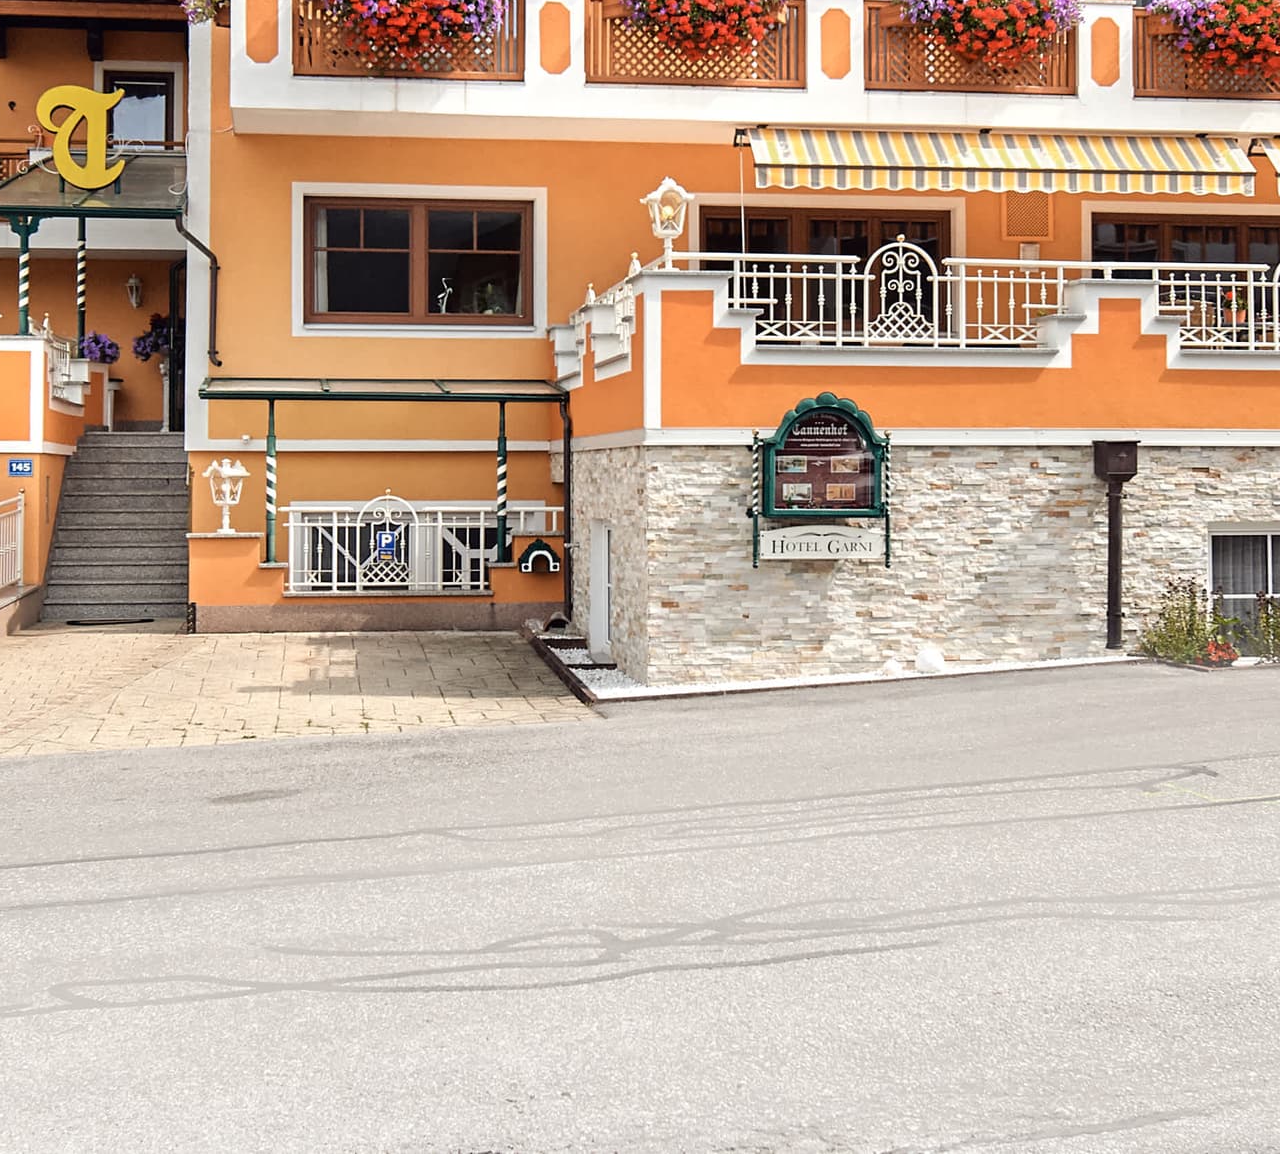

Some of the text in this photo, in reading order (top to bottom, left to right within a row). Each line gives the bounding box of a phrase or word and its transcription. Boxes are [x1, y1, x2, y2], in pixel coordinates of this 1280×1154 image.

[792, 423, 848, 436] Tannenhof
[11, 462, 31, 472] 145
[381, 533, 393, 548] P
